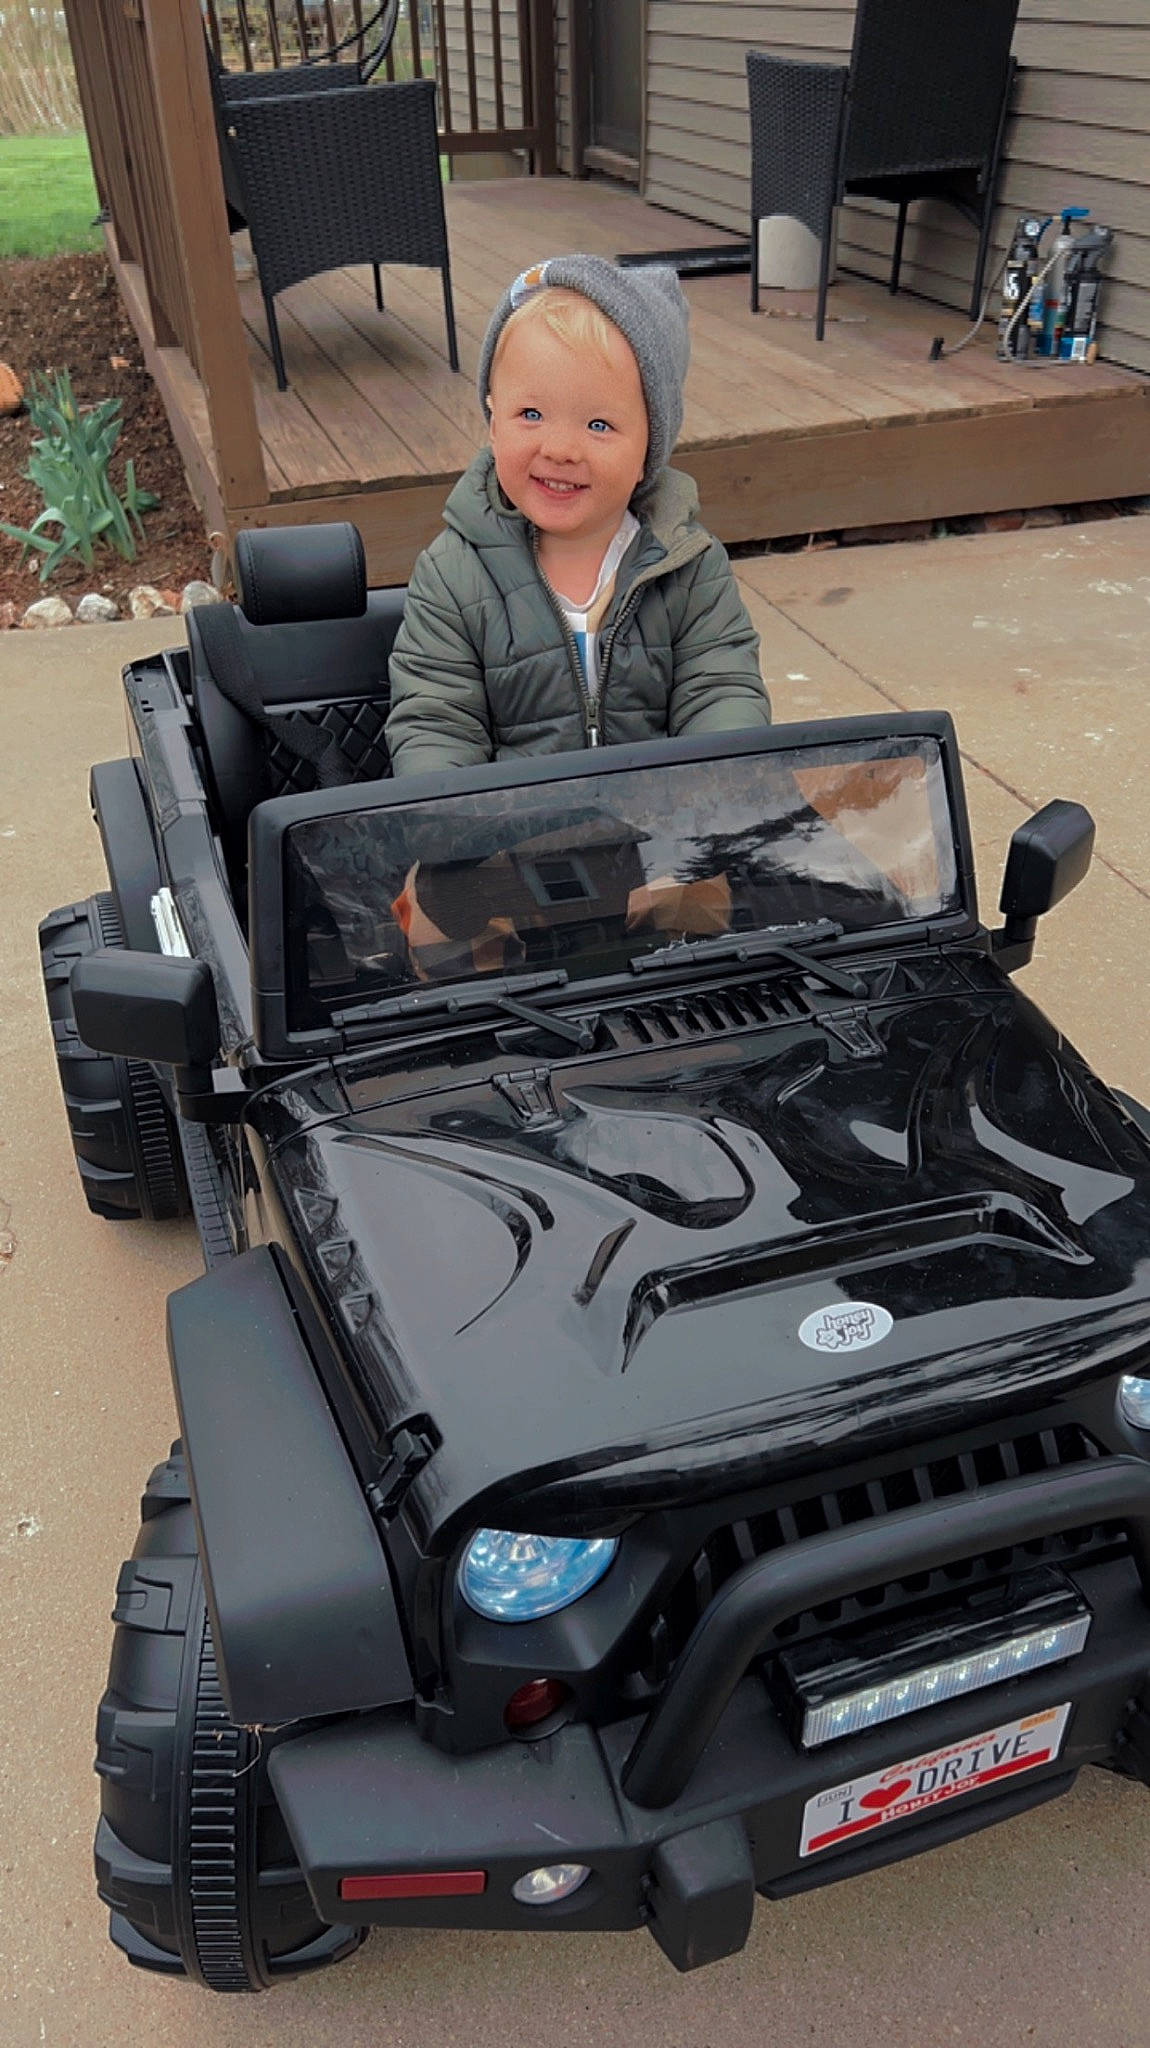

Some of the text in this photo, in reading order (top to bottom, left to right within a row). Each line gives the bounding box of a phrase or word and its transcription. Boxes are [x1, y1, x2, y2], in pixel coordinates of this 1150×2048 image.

[824, 1308, 874, 1331] honey
[841, 1323, 871, 1346] joy
[879, 1733, 996, 1783] California
[837, 1730, 1035, 1825] I DRIVE
